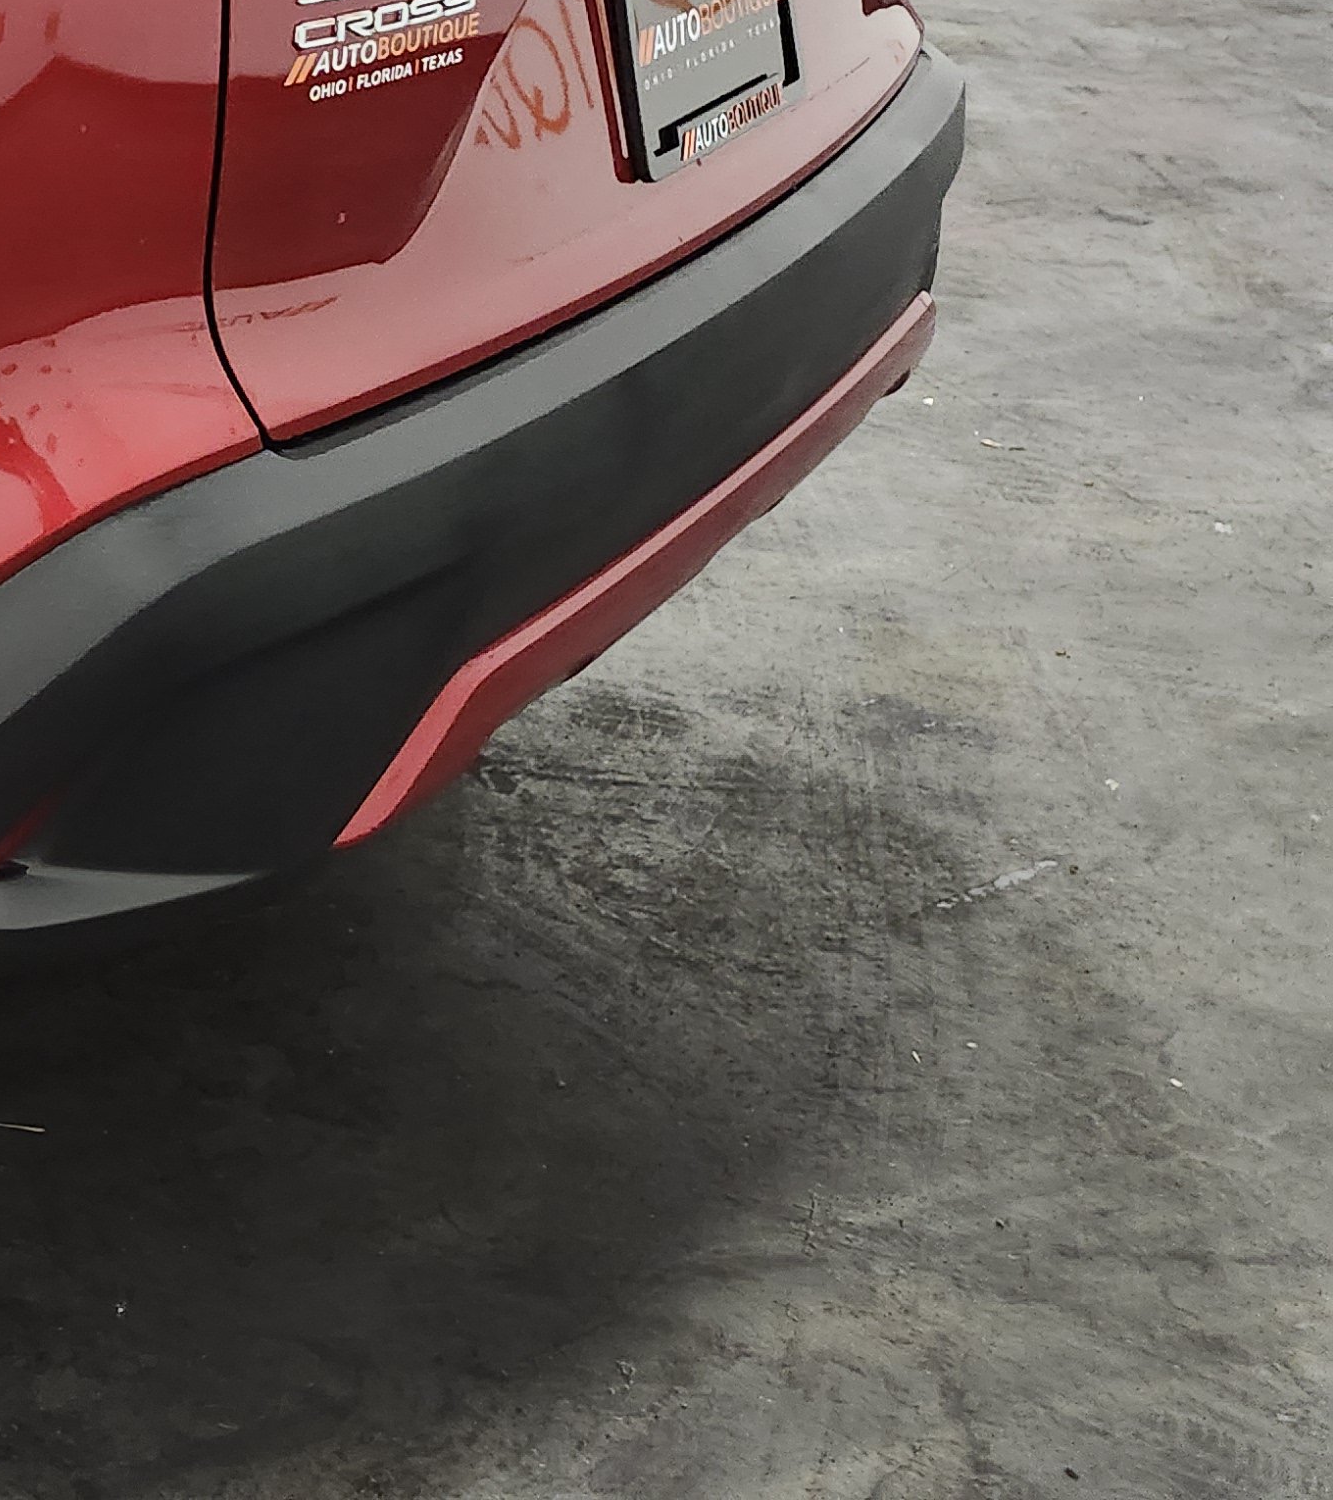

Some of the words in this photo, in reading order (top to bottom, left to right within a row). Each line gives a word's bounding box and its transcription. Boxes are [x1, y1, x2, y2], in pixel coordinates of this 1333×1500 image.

[309, 78, 346, 102] OHIO
[355, 61, 413, 91] FLORIDA
[421, 48, 464, 72] TEXAS
